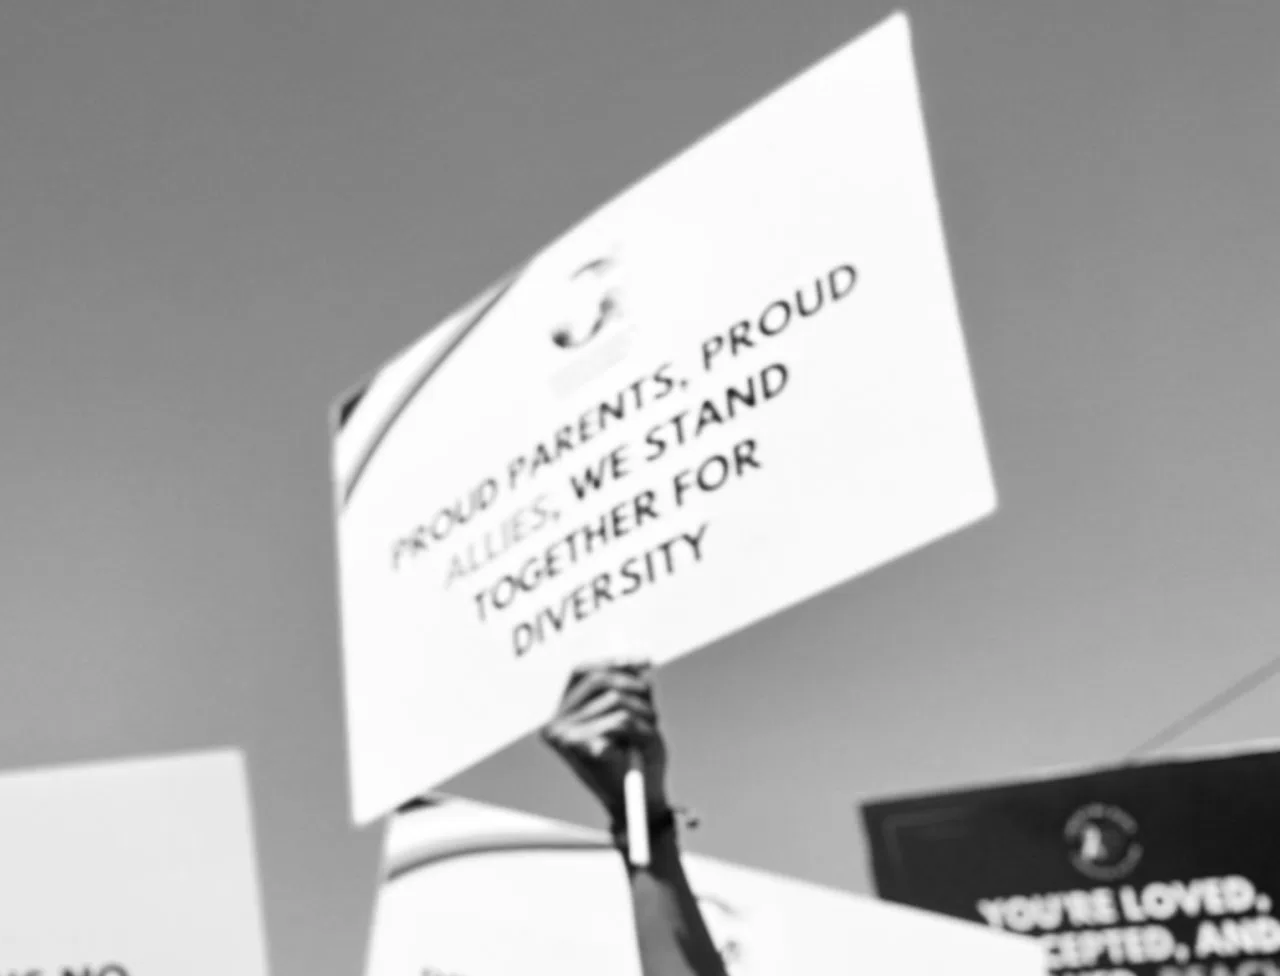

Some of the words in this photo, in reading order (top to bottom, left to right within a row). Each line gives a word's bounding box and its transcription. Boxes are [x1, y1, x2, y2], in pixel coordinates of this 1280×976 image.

[391, 476, 498, 572] PROUD
[701, 263, 859, 372] PROUD
[570, 442, 629, 500] WE
[645, 361, 789, 463] STAND
[474, 489, 659, 622] TOGETHER
[673, 437, 762, 507] FOR
[512, 522, 709, 659] DIVERSITY
